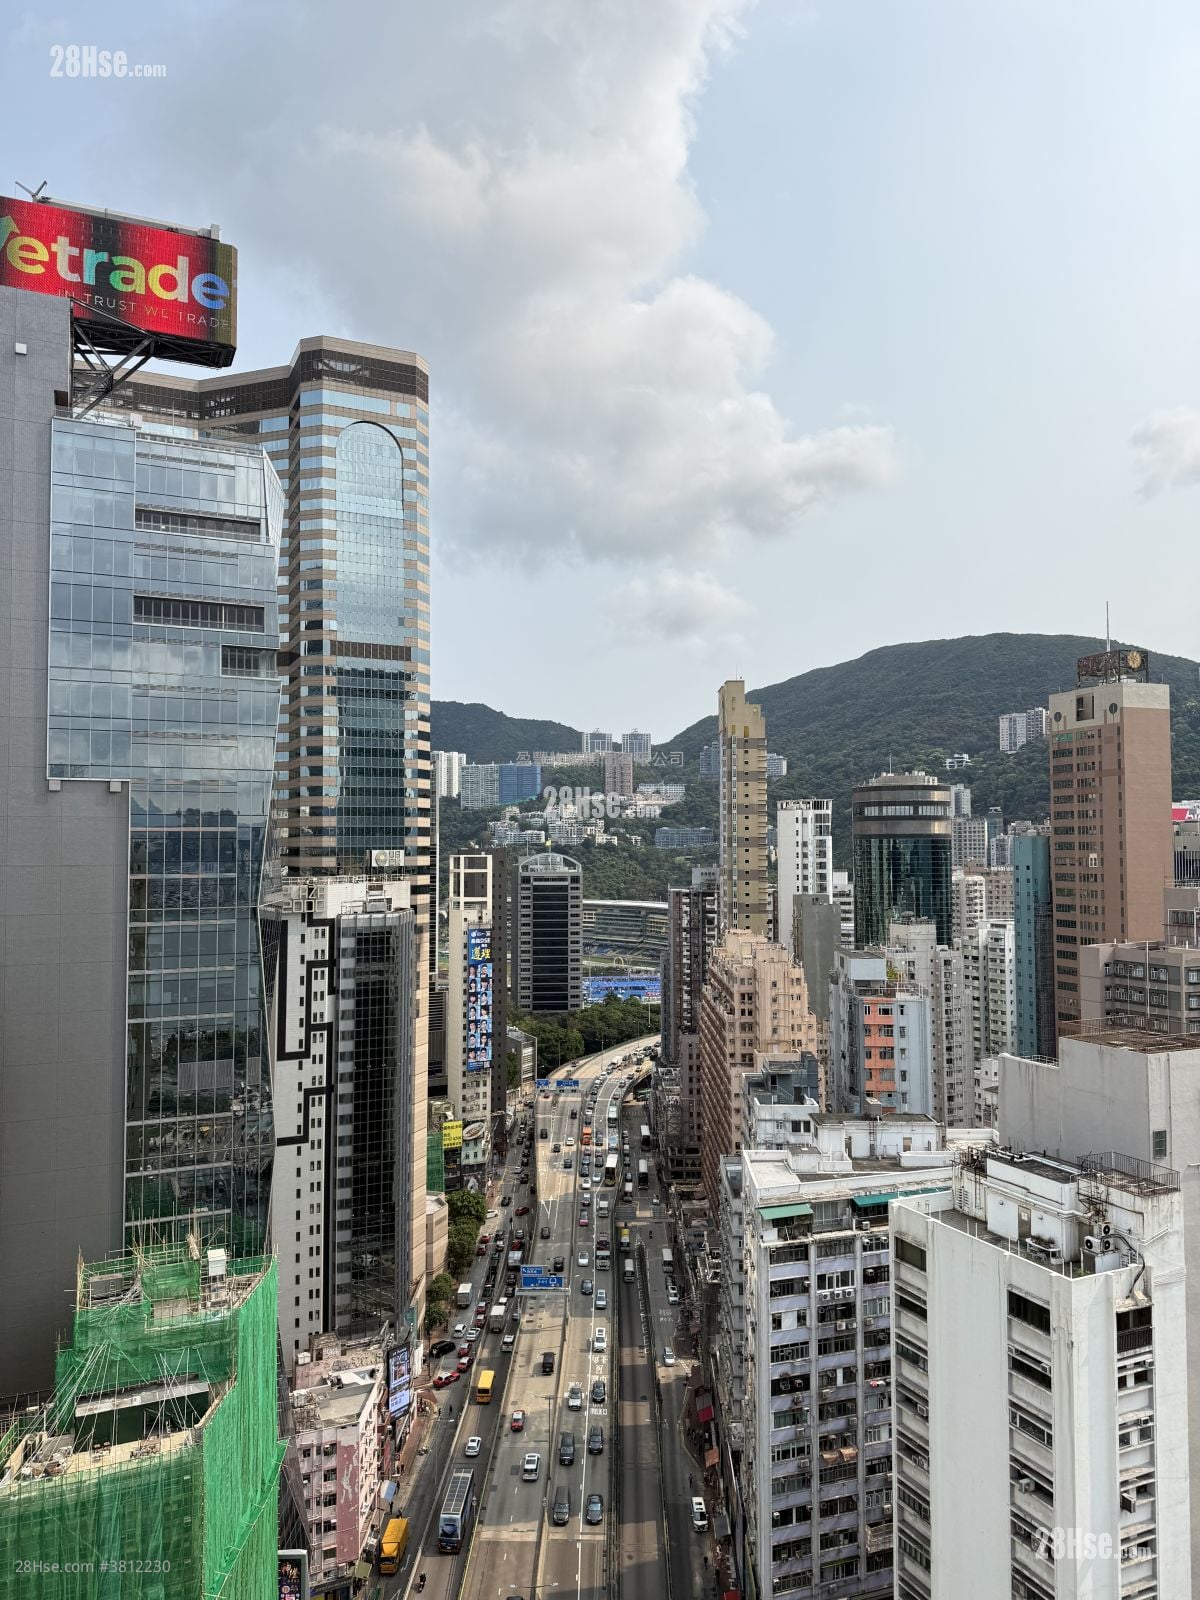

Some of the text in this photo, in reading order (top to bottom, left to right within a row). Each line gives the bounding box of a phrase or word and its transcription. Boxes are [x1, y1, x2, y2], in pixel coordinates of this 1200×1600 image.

[84, 293, 137, 312] TRUST
[145, 305, 169, 319] WE
[179, 311, 229, 328] TRADE
